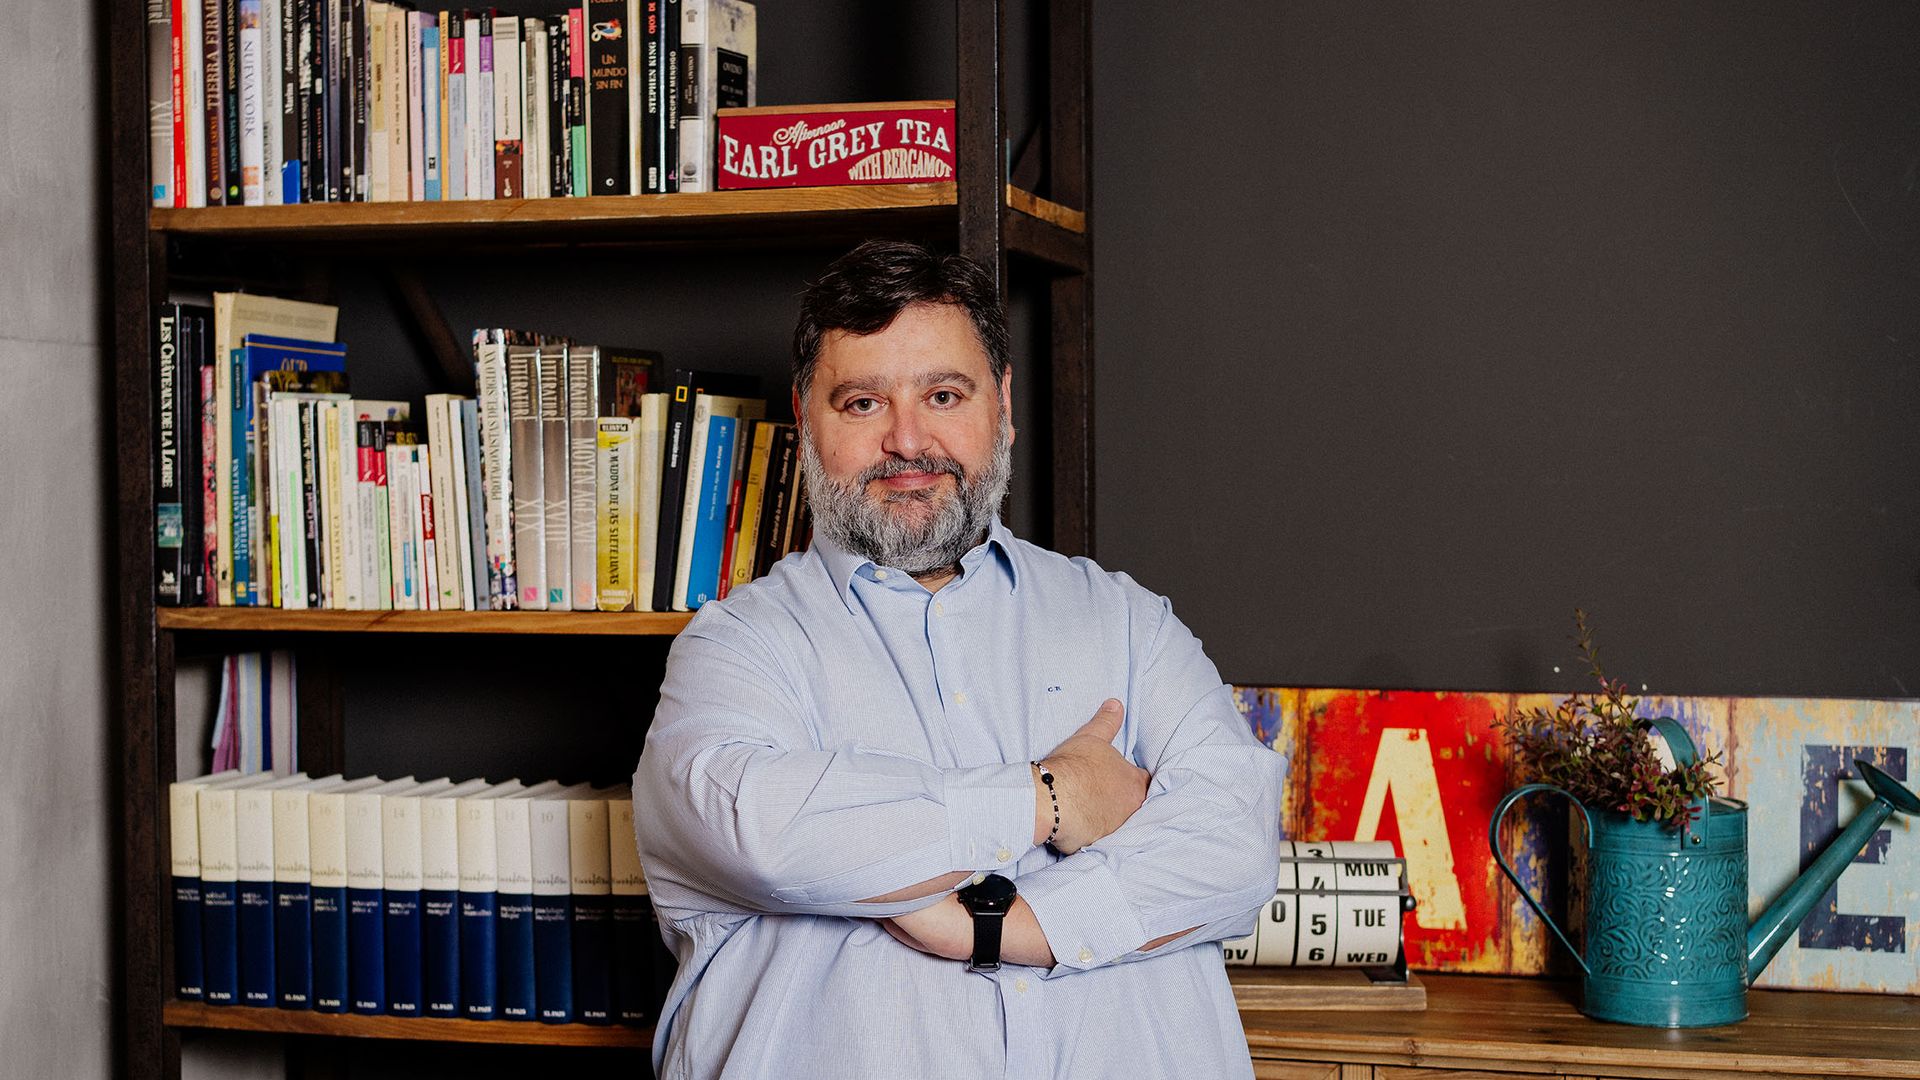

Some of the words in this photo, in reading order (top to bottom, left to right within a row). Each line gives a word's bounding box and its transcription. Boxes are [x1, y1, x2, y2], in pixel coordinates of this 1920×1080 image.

[647, 14, 657, 34] OJOS
[243, 40, 254, 91] NUEVA
[601, 54, 617, 65] UN
[647, 41, 657, 67] KING
[206, 51, 220, 110] TIERRA
[592, 67, 627, 78] MUNDO
[668, 50, 677, 87] MENDIGO
[596, 80, 609, 90] SIN
[610, 80, 624, 89] FIN
[648, 68, 657, 114] STEPHEN
[284, 83, 294, 115] Marina
[244, 93, 255, 138] YORK
[772, 118, 847, 149] Afternoon
[722, 134, 798, 179] EARL
[808, 121, 885, 169] GREY
[896, 118, 951, 153] TEA
[848, 150, 882, 181] WITH
[881, 148, 953, 179] BERGAMOT
[160, 315, 174, 342] LES
[483, 350, 495, 364] XX
[484, 366, 497, 397] SIGLO
[161, 409, 174, 430] DE
[486, 397, 498, 419] DEL
[161, 430, 174, 447] LA
[609, 441, 619, 453] LA
[161, 447, 175, 488] LOIRE
[488, 422, 501, 501] PROTAGONISTAS
[571, 437, 597, 486] MOYEN
[782, 447, 792, 461] King
[779, 460, 788, 484] Stephen
[609, 493, 619, 505] DE
[609, 507, 619, 525] LAS
[609, 527, 619, 554] SIETE
[609, 555, 619, 585] LUNAS
[1799, 743, 1907, 954] E
[1311, 876, 1326, 898] 4
[1345, 863, 1389, 877] MON
[1311, 914, 1327, 936] 5
[1352, 909, 1387, 928] TUE
[1223, 948, 1249, 960] OV
[1308, 948, 1325, 961] 6
[1346, 952, 1389, 963] WED
